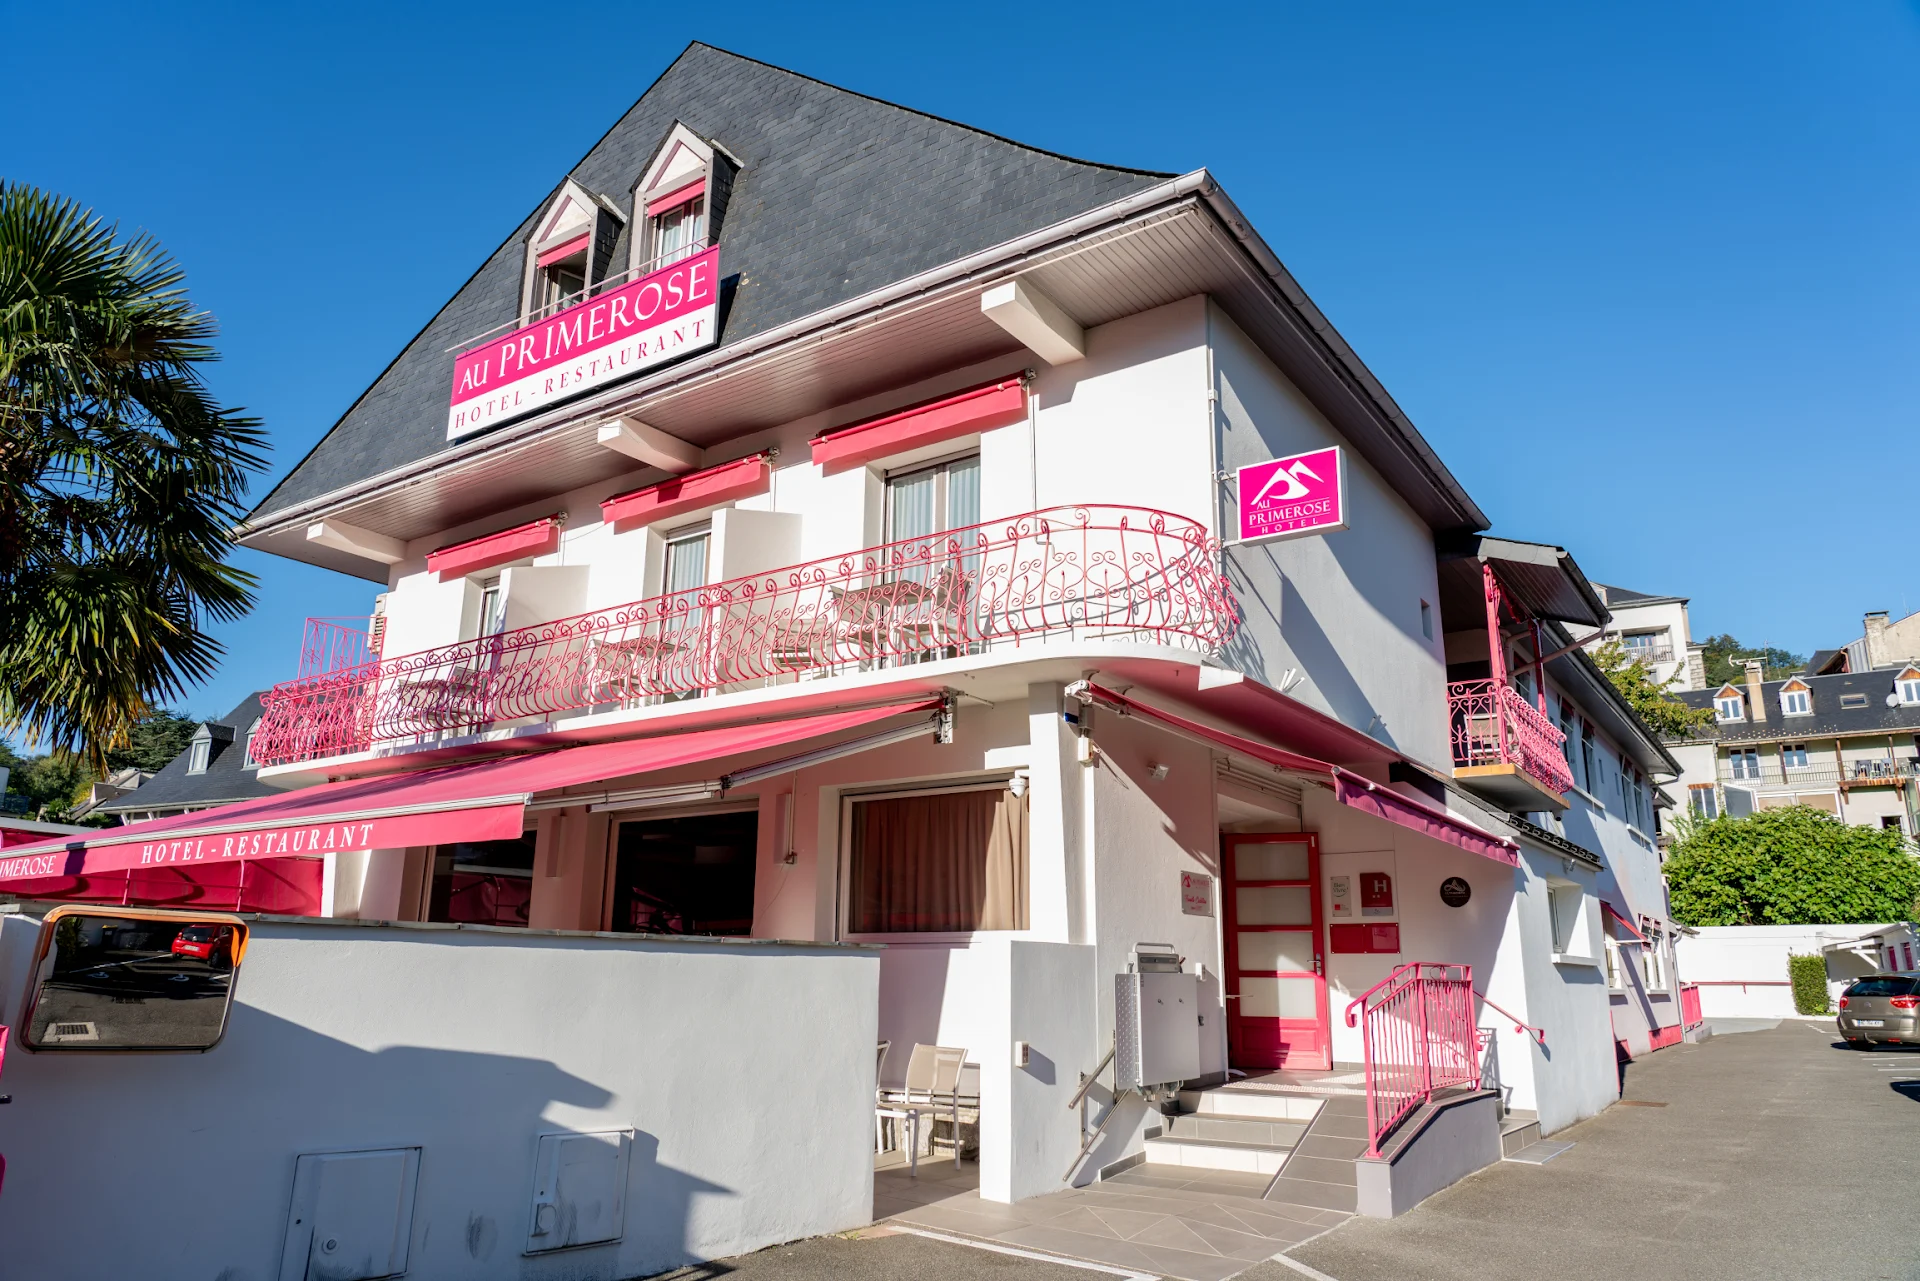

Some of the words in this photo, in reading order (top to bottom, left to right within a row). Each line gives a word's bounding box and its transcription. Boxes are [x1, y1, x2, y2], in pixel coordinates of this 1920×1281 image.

[458, 359, 490, 395] AU
[498, 260, 709, 379] PRIMEROSE
[454, 390, 523, 429] HOTEL
[543, 319, 706, 395] RESTAURANT
[1248, 500, 1331, 526] PRIMEROSE
[1256, 499, 1270, 510] AU
[1261, 517, 1319, 534] HOTEL
[140, 839, 204, 864] HOTEL
[222, 823, 374, 857] RESTAURANT
[1373, 879, 1388, 893] H
